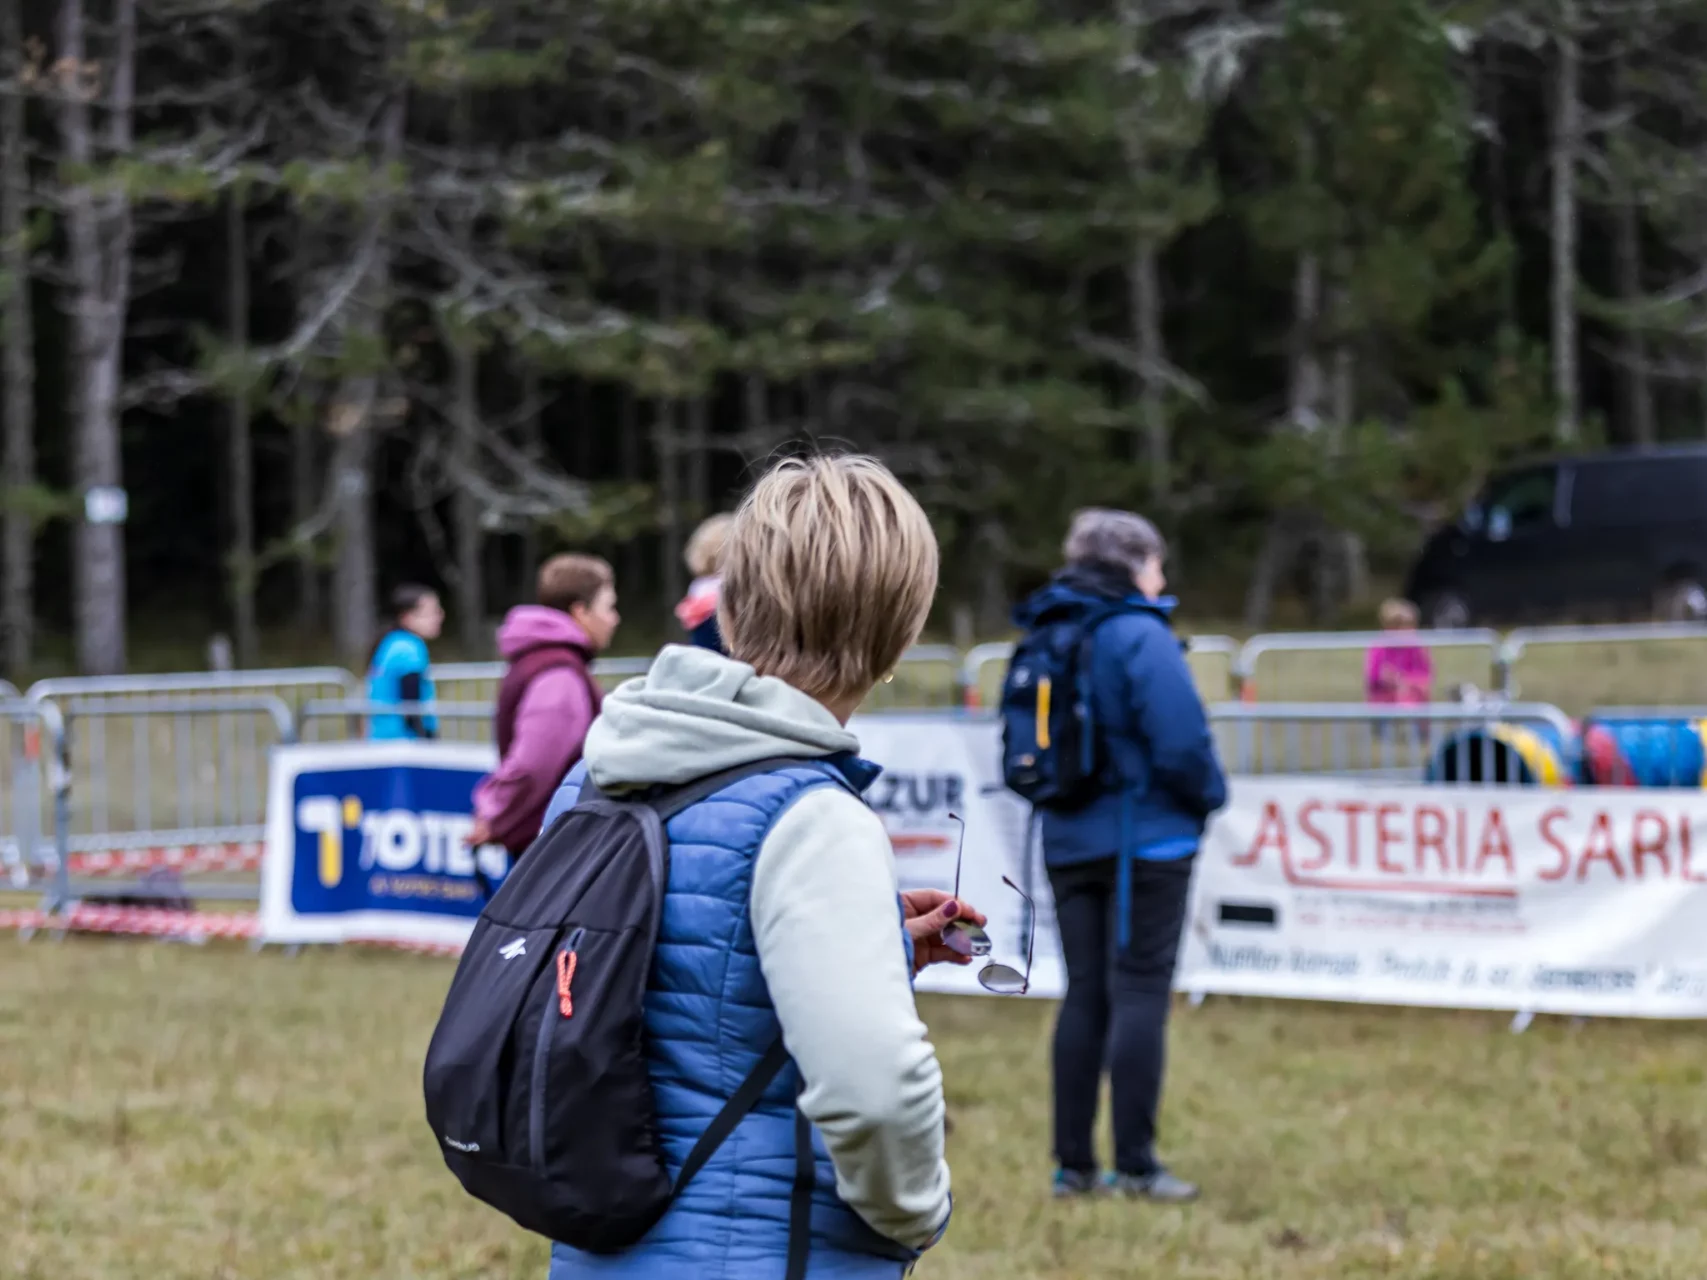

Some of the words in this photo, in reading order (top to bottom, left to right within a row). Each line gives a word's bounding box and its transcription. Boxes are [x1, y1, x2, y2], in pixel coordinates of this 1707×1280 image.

[862, 770, 967, 815] ZUR
[1230, 800, 1515, 890] ASTERIA
[1537, 806, 1707, 884] SARL
